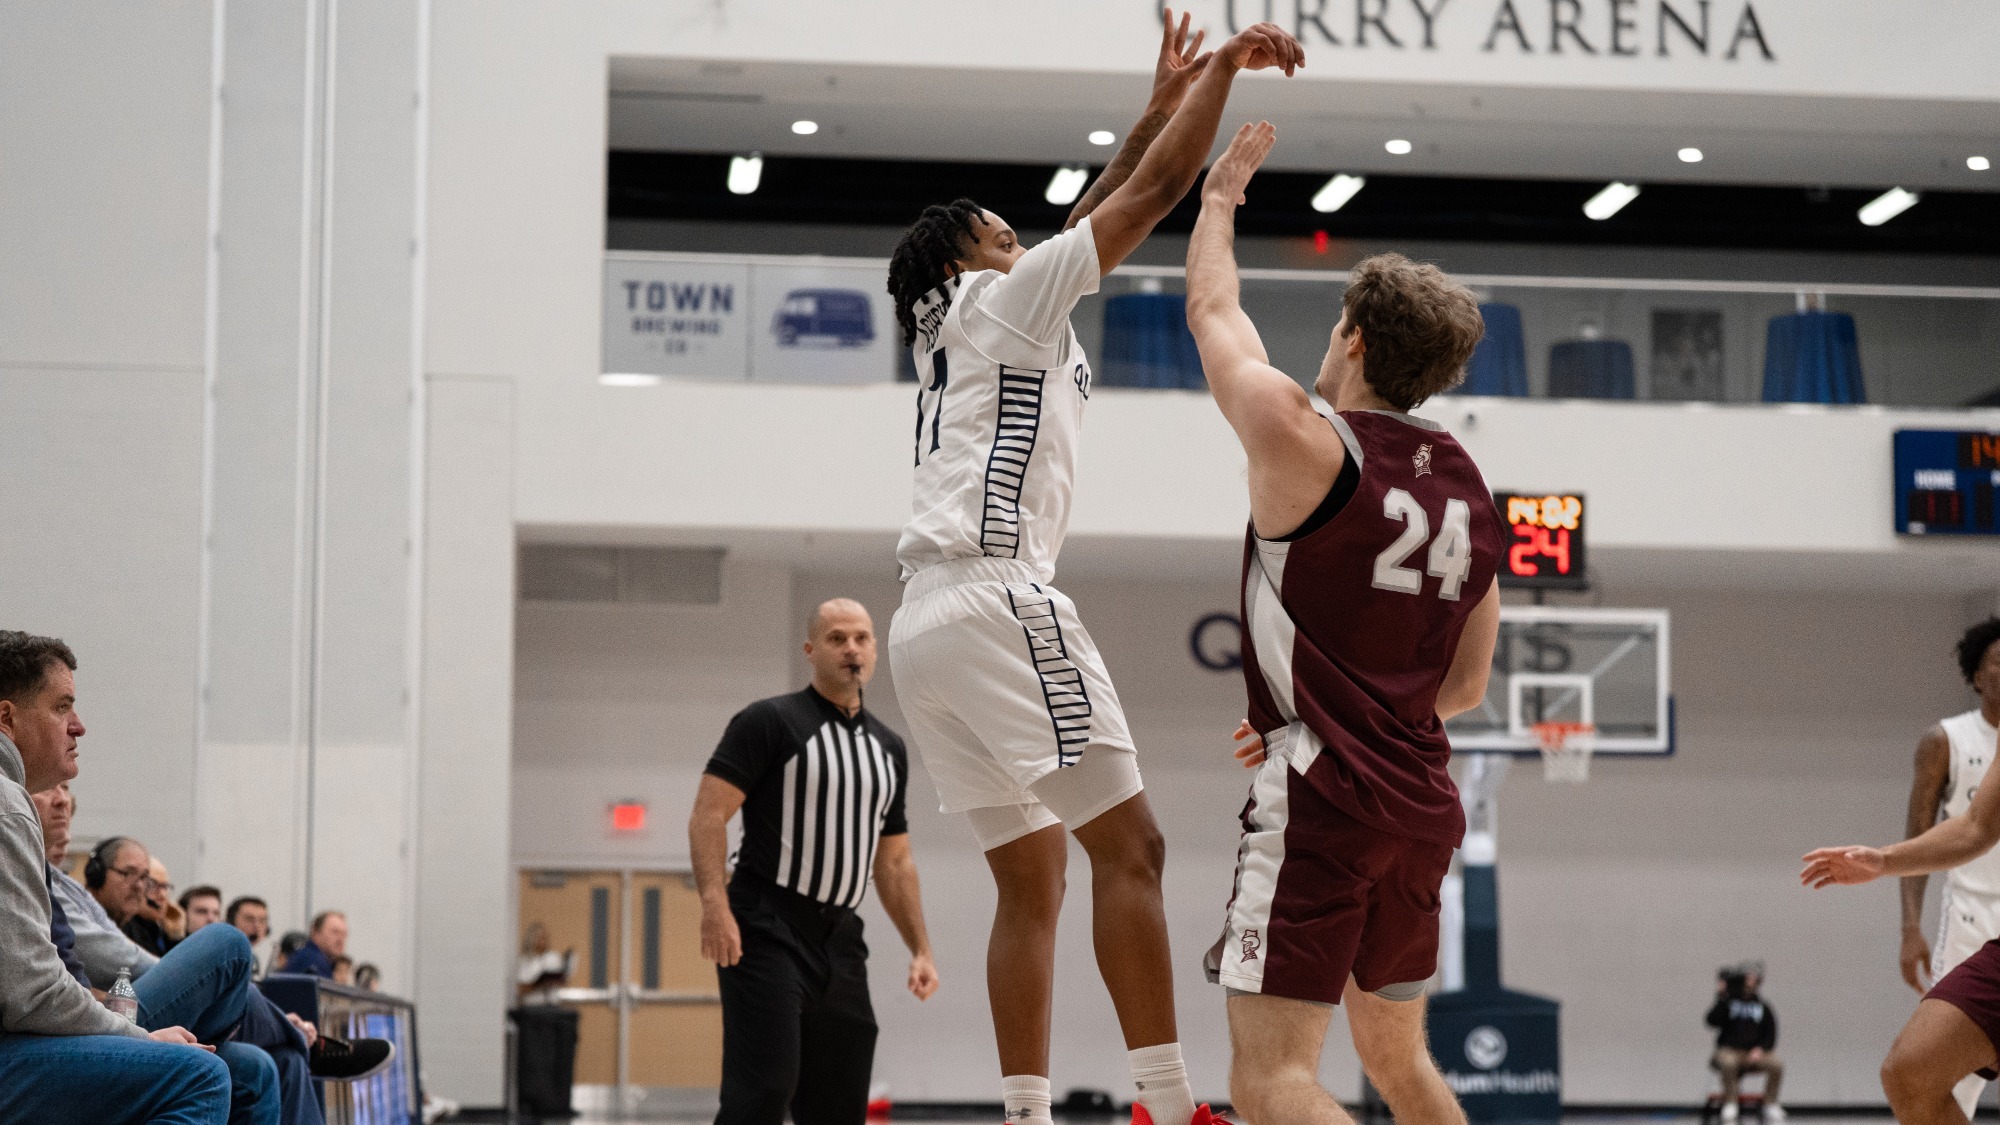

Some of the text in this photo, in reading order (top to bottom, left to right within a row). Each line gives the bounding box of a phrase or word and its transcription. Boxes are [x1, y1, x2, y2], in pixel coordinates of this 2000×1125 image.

[1482, 0, 1776, 61] ARENA
[623, 280, 735, 314] TOWN
[631, 316, 723, 336] BREWING
[1371, 487, 1472, 601] 24
[1509, 524, 1571, 576] 24
